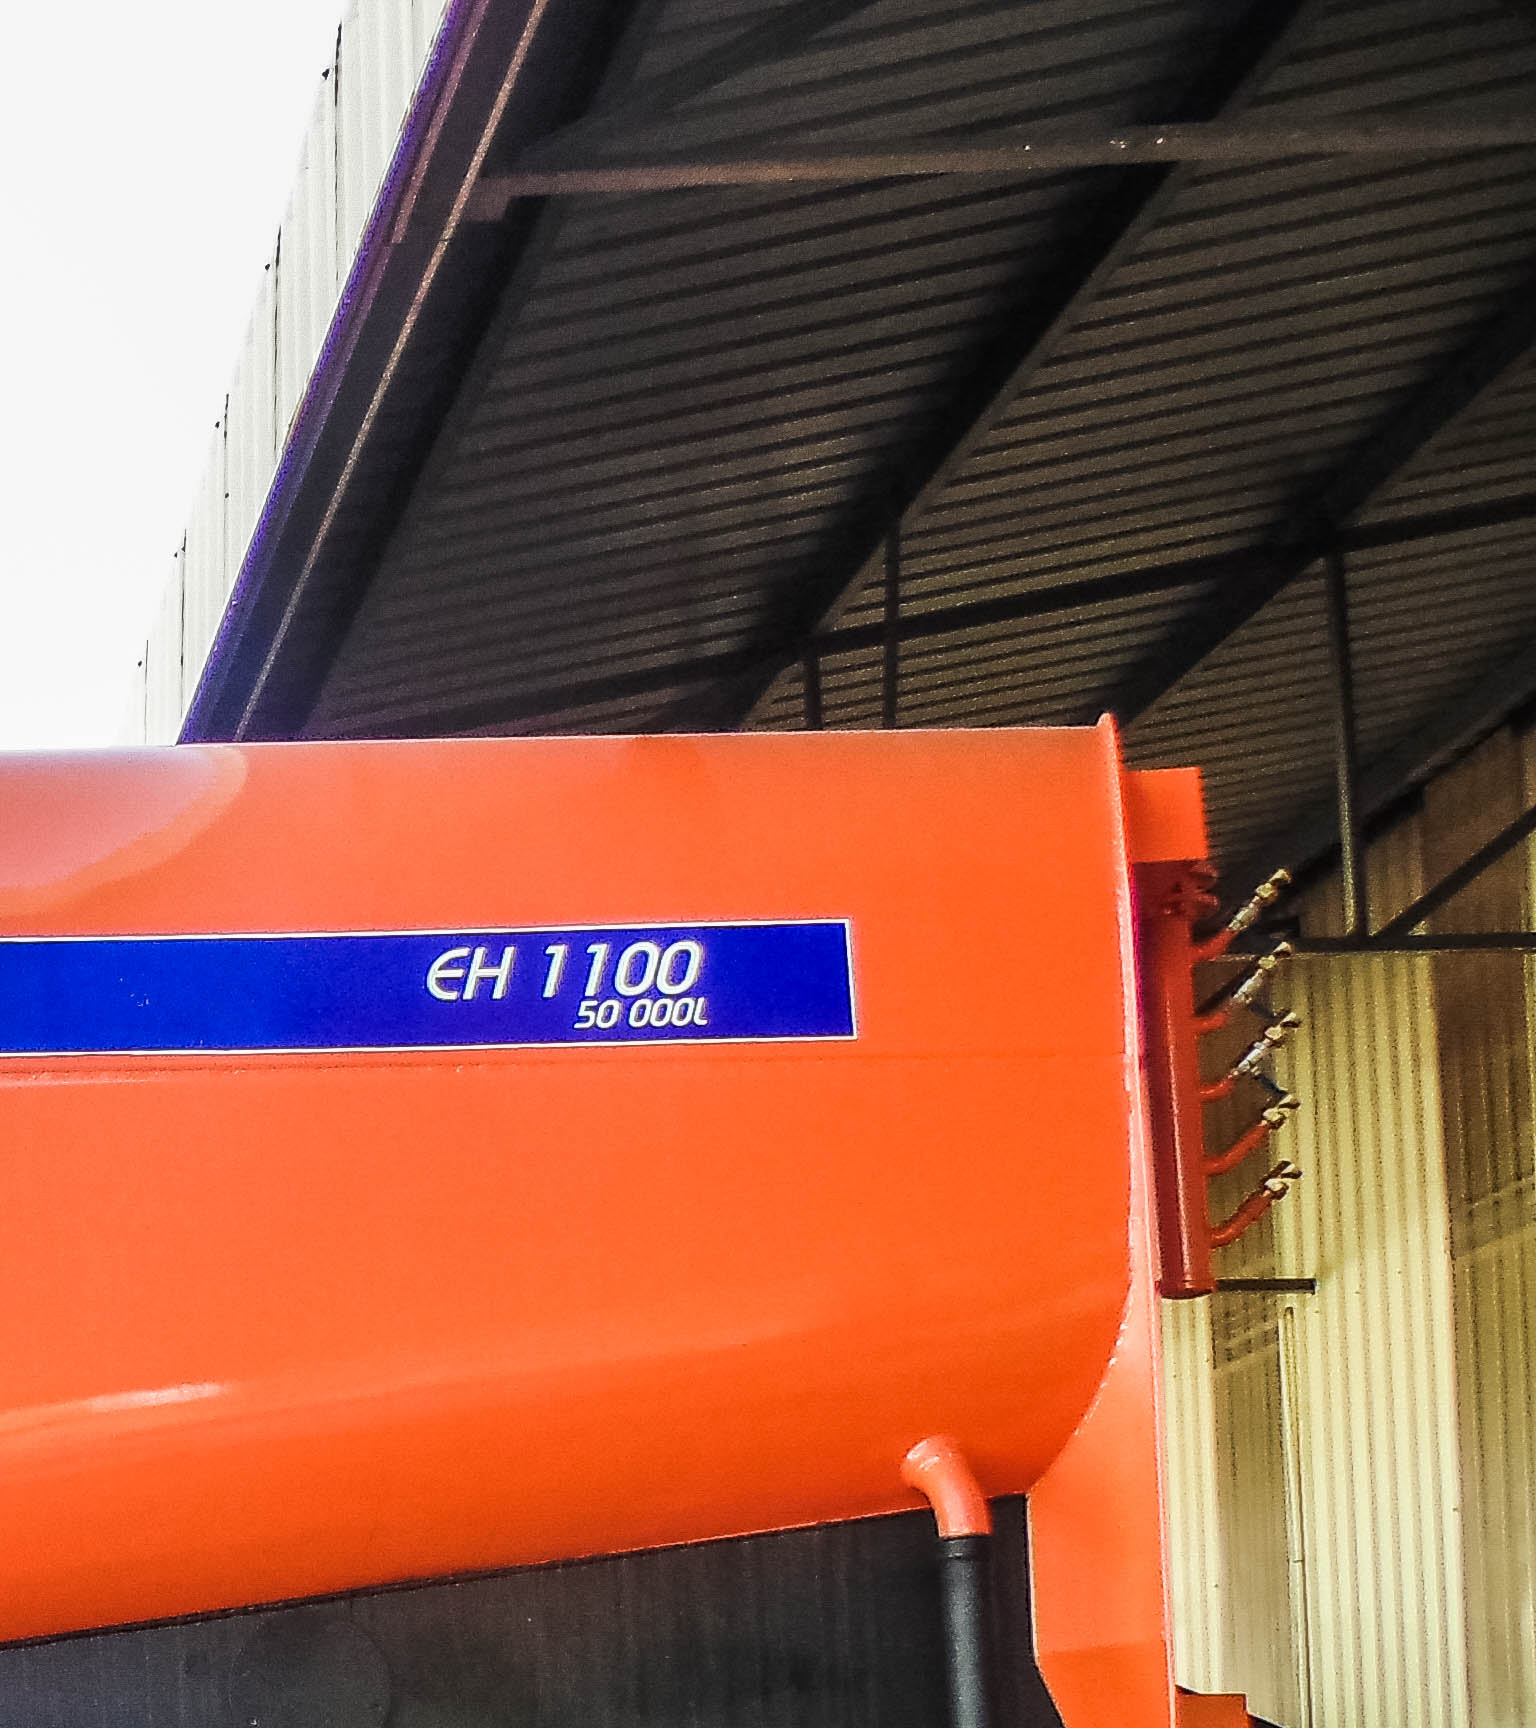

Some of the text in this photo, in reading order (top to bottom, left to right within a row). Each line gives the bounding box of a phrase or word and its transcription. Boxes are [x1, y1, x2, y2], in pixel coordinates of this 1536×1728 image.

[426, 938, 704, 1001] EH 1100
[573, 999, 618, 1029] 50
